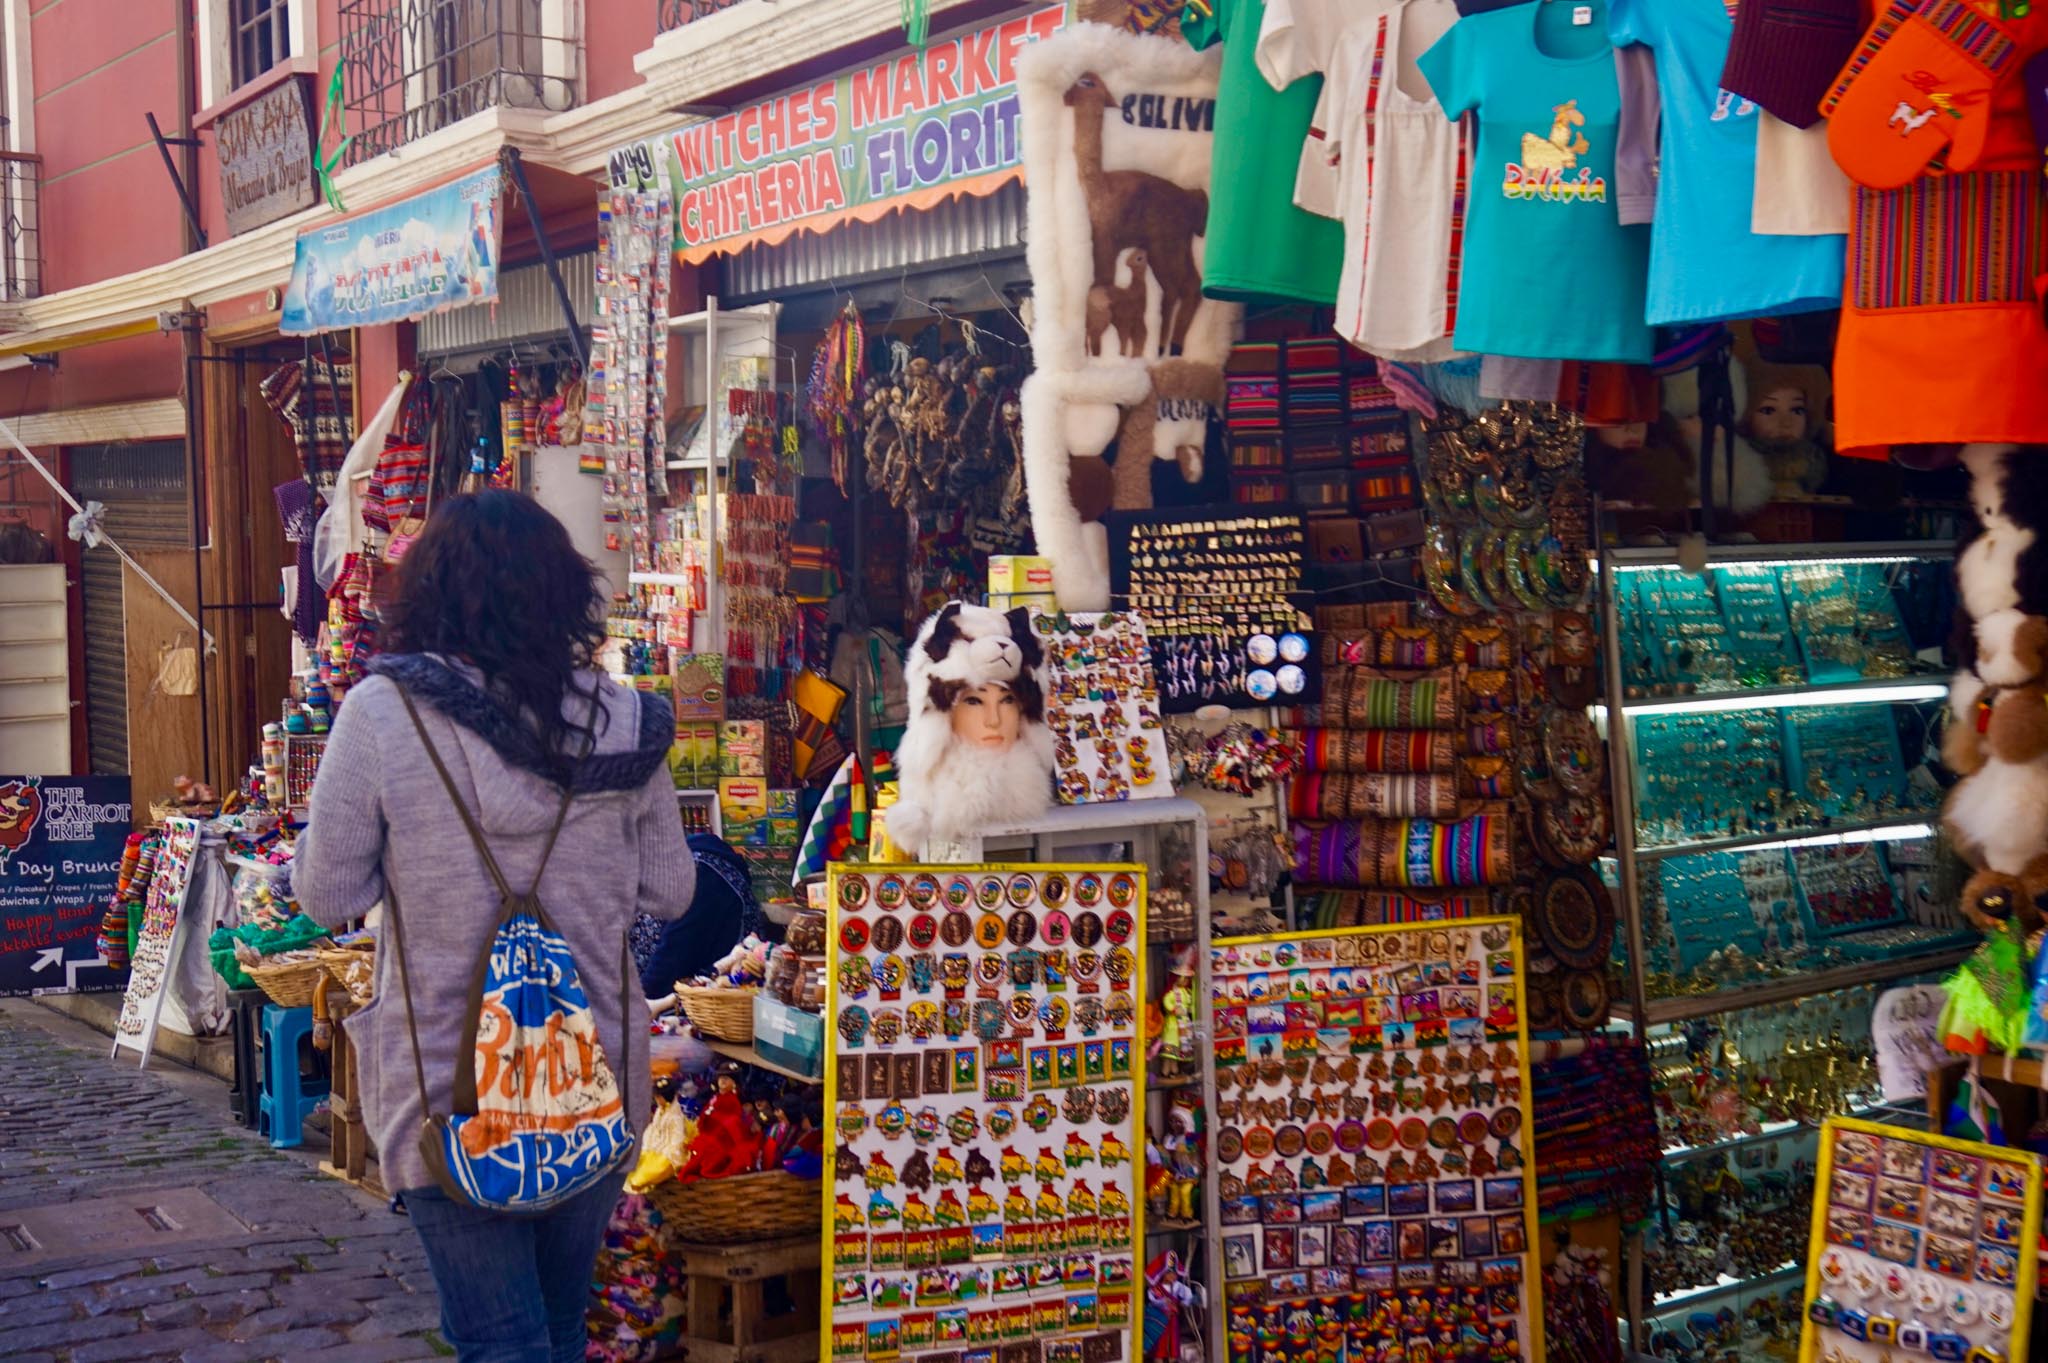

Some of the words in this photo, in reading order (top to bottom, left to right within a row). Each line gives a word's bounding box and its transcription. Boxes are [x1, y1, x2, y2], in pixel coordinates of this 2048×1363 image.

[673, 81, 838, 182] WITCHES
[1502, 162, 1607, 204] Bolivia
[45, 787, 84, 806] THE
[45, 804, 131, 823] CARROT
[46, 822, 95, 841] TREE
[18, 861, 54, 883] Day
[53, 894, 85, 906] Wraps
[6, 914, 54, 938] Happy
[58, 903, 95, 920] Hour
